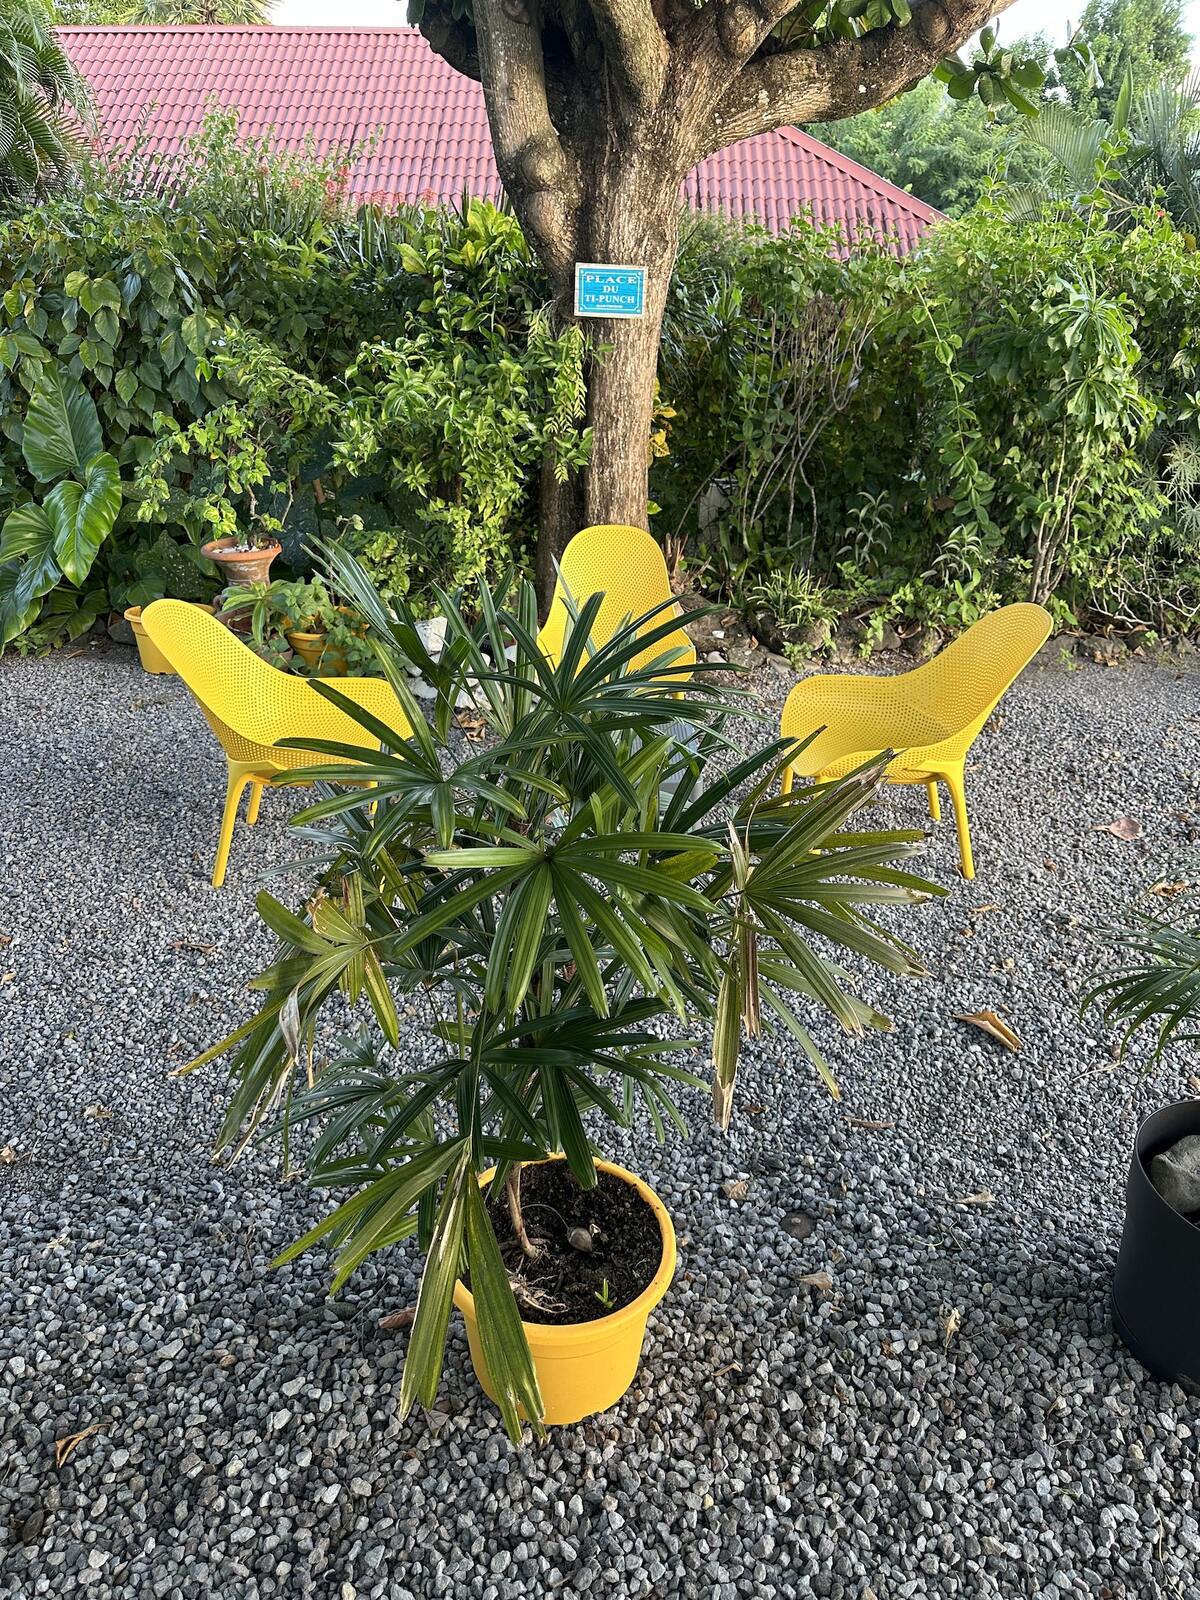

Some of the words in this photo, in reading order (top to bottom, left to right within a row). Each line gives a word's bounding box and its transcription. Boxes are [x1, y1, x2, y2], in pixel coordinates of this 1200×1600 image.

[585, 275, 637, 284] PLACE
[603, 285, 619, 293] DU
[585, 294, 635, 304] TI-PUNCH
